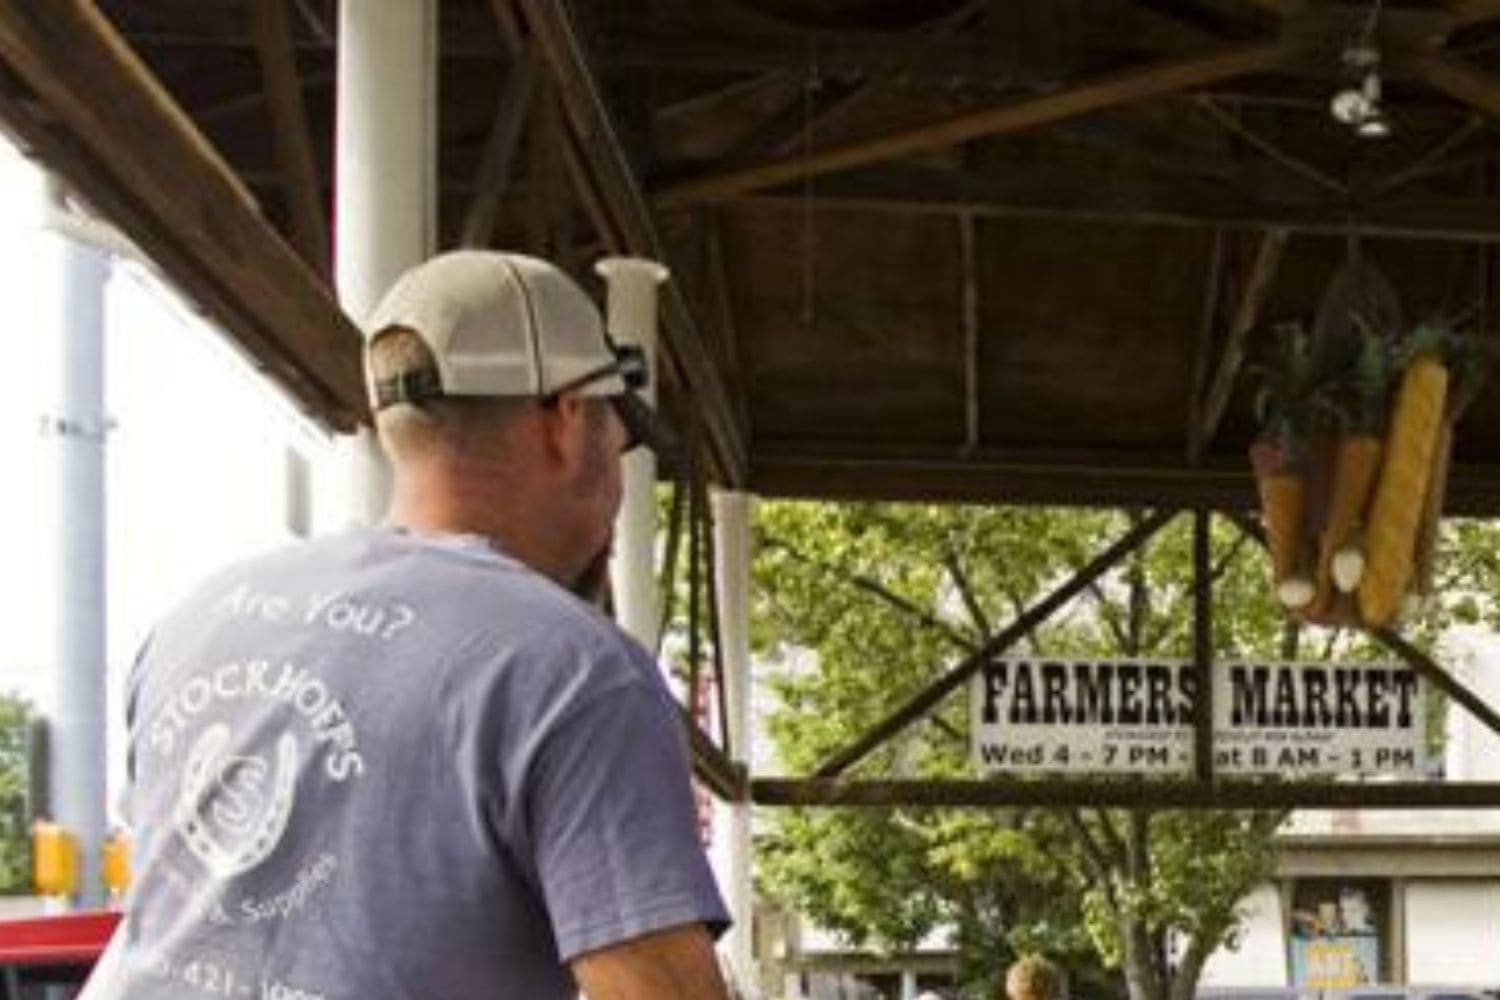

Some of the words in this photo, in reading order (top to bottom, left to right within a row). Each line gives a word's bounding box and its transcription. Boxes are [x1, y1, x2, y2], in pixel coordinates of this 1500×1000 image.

[303, 590, 416, 640] You?
[981, 661, 1200, 726] FARMERS
[1230, 666, 1419, 728] MARKET
[980, 744, 1044, 765] Wed
[1052, 746, 1070, 765] 4
[1103, 746, 1119, 765] 7
[1129, 745, 1168, 765] PM
[1215, 747, 1242, 767] at
[1252, 747, 1267, 766] 8
[1277, 747, 1320, 766] AM
[1351, 748, 1361, 768] 1
[1376, 748, 1414, 768] PM
